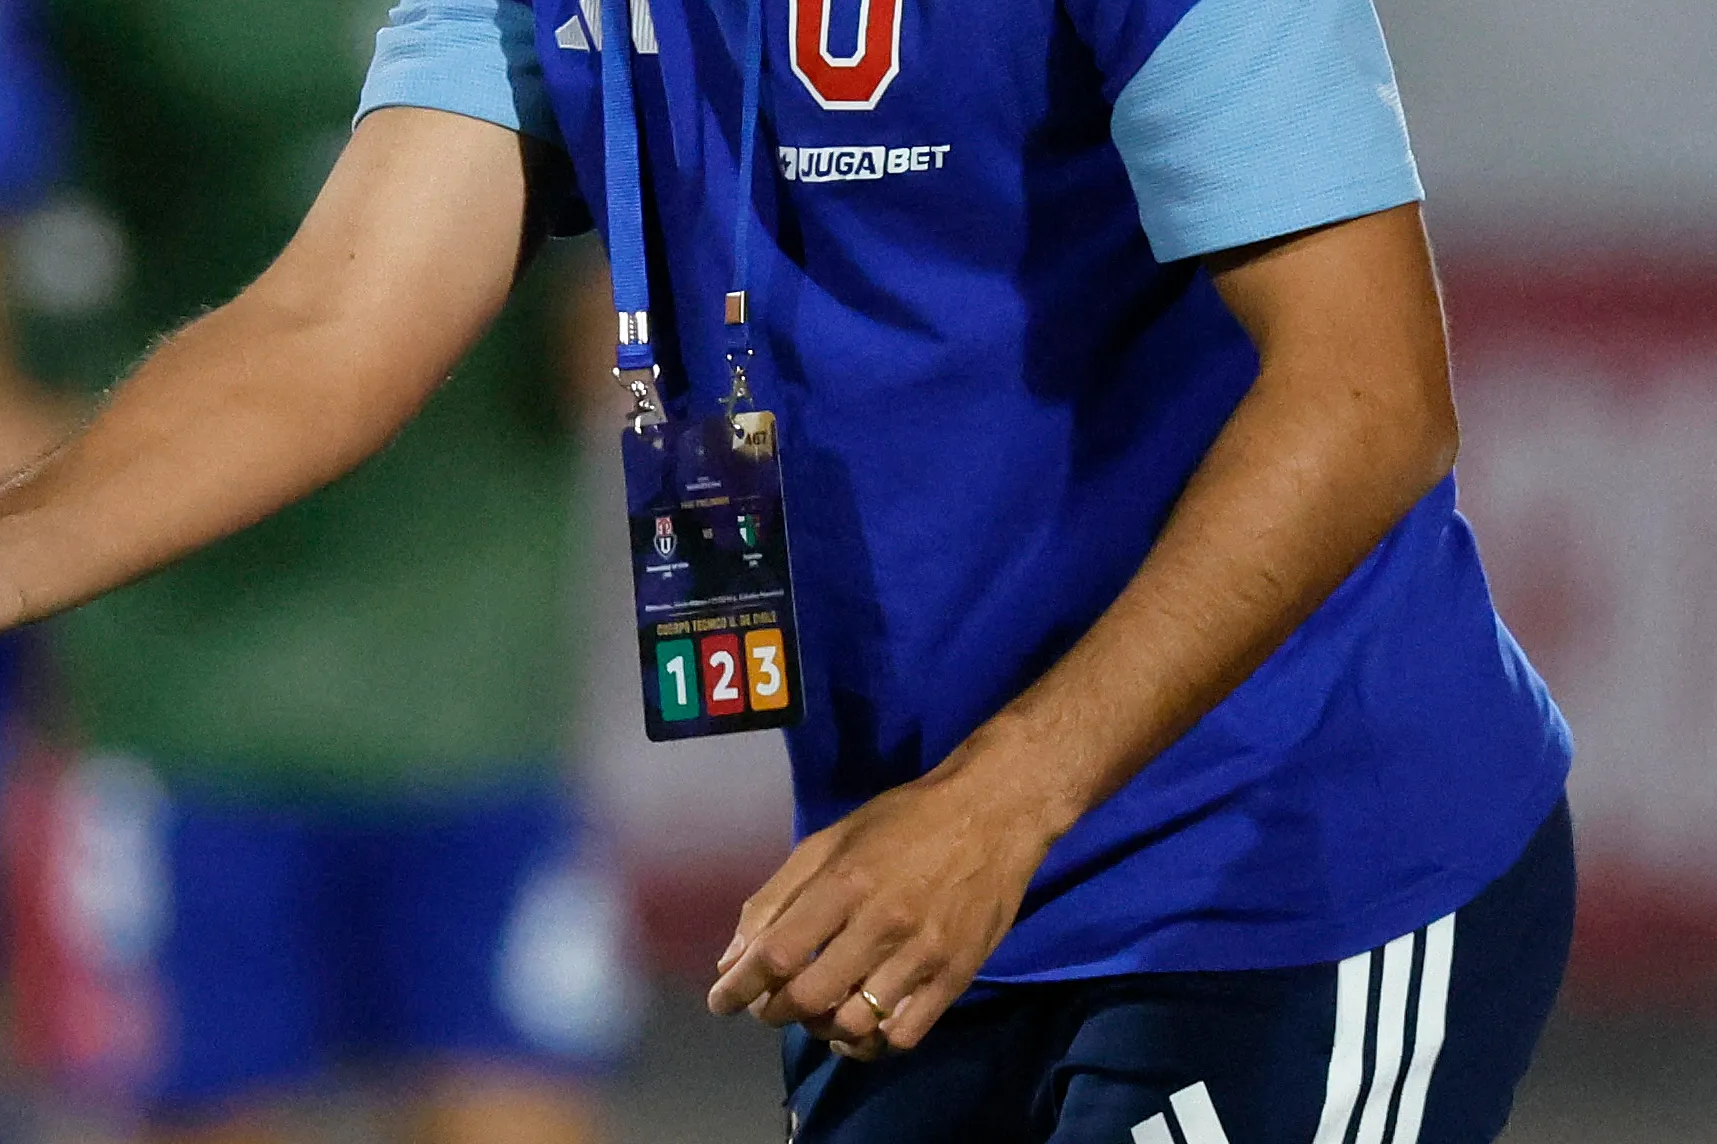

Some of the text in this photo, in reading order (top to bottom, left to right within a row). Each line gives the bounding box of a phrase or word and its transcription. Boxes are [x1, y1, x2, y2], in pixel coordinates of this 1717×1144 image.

[666, 645, 782, 705] 1 2 3
